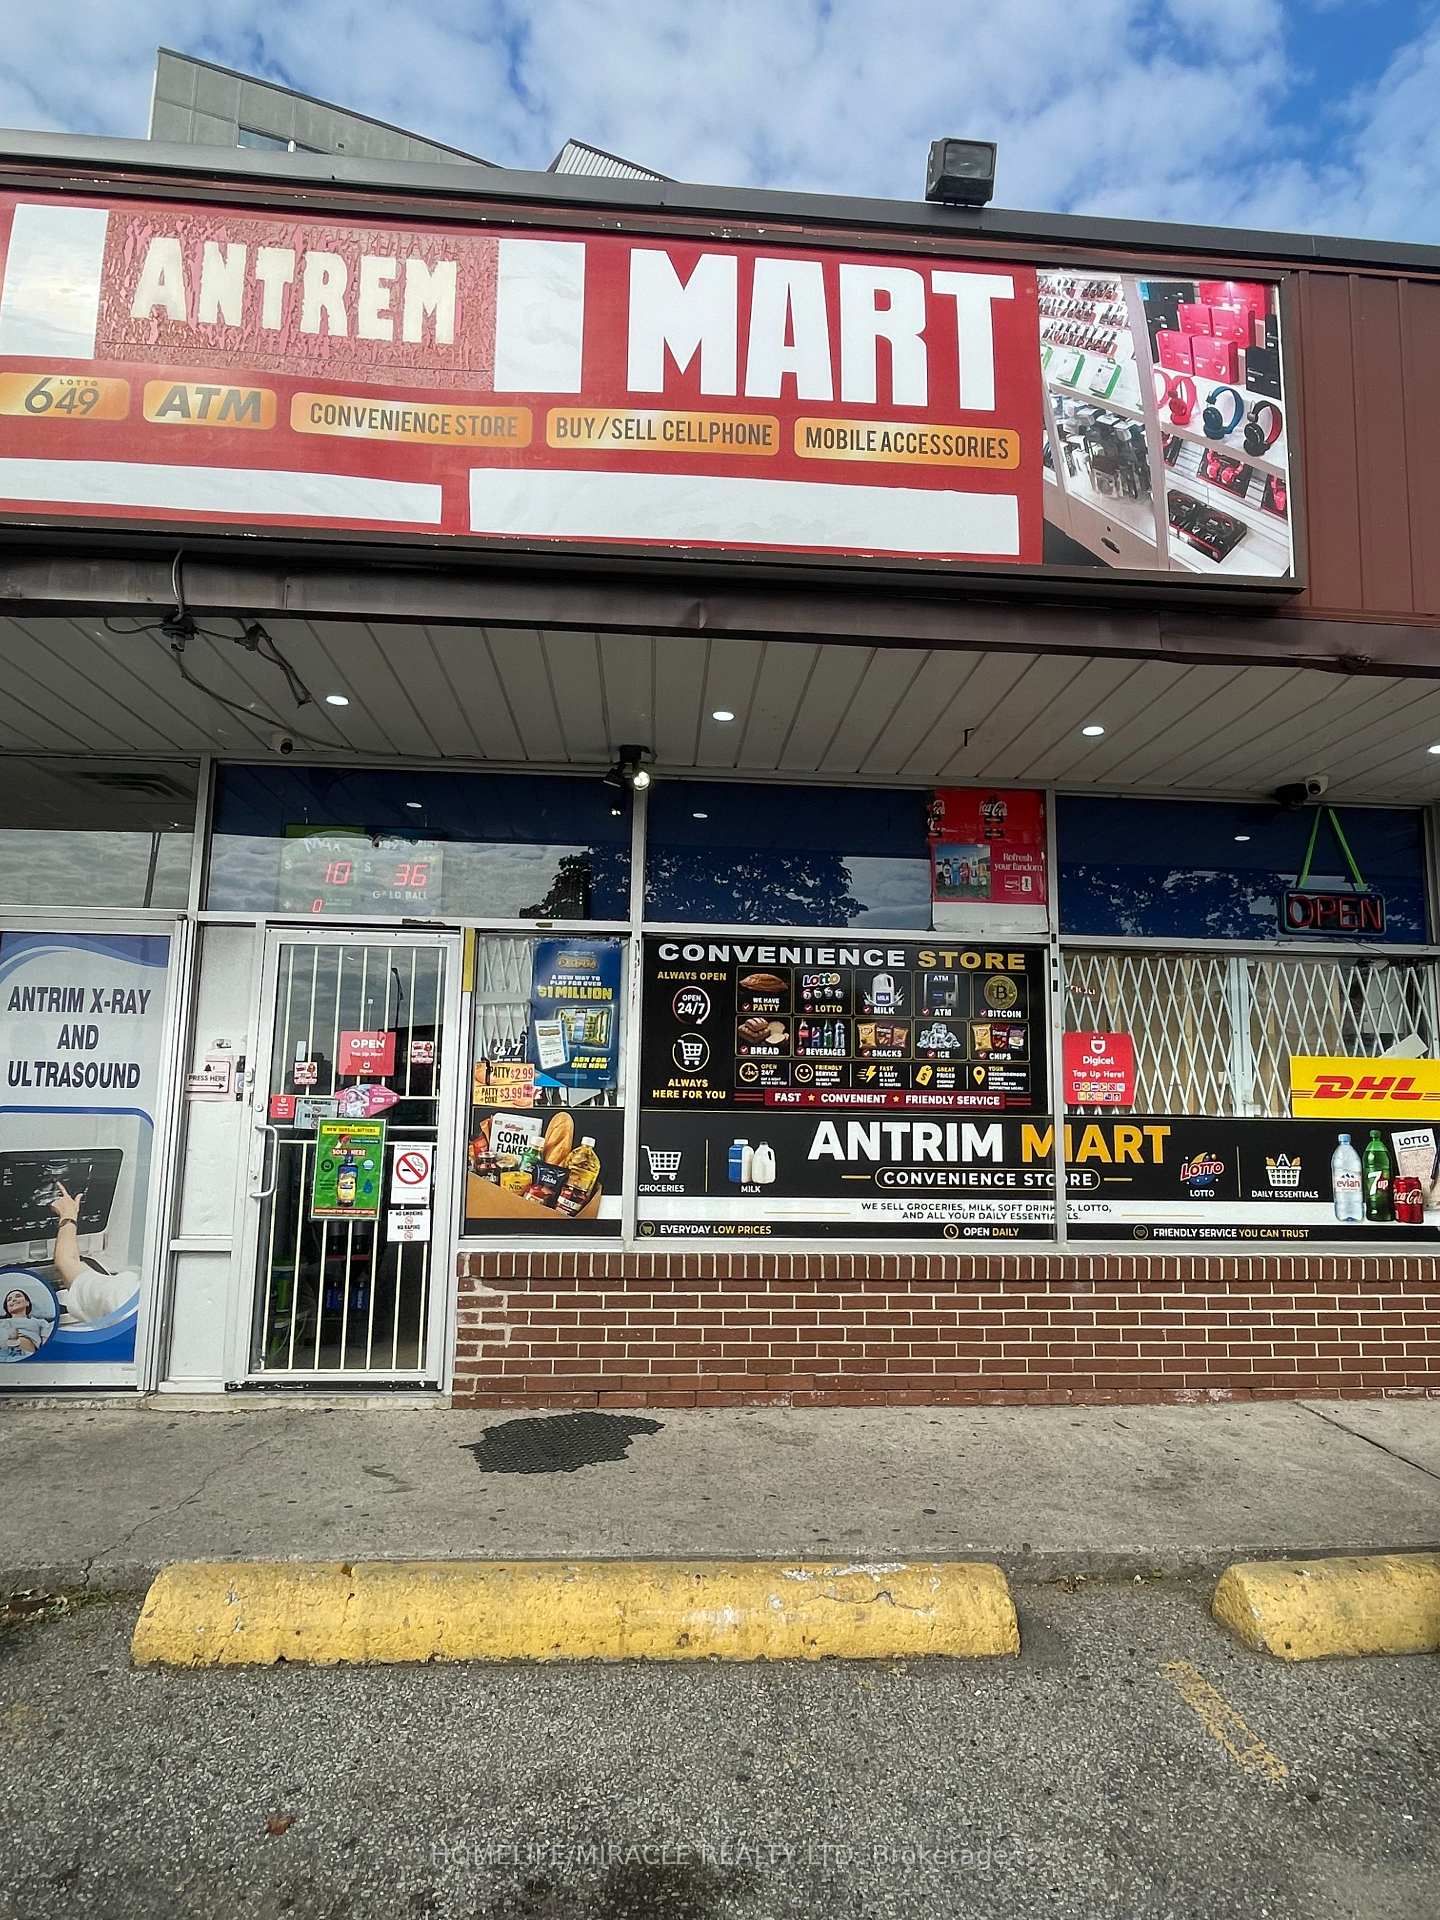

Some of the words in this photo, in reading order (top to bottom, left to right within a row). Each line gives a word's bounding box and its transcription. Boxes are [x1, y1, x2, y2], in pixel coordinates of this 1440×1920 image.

[130, 237, 457, 345] ANTREM
[626, 248, 1015, 412] MART
[25, 377, 99, 415] 649
[155, 385, 262, 423] ATM
[310, 402, 451, 435] CONVENIENCE
[455, 414, 518, 437] STORE
[556, 417, 657, 441] BUY/SELL
[662, 420, 772, 446] CELLPHONE
[806, 427, 877, 451] MOBILE
[881, 431, 1009, 460] ACCESSORIES
[1003, 853, 1032, 861] Refresh
[323, 861, 351, 885] 10
[393, 863, 428, 887] 36
[1289, 895, 1382, 929] OPEN
[658, 944, 905, 967] CONVENIENCE
[918, 951, 1026, 971] STORE
[657, 971, 697, 980] ALWAYS
[700, 972, 727, 981] OPEN
[555, 987, 613, 1000] MILLION
[8, 986, 84, 1013] ANTRIM
[90, 988, 151, 1015] X-RAY
[677, 1002, 705, 1015] 24/7
[753, 1004, 779, 1012] PATTY
[934, 1008, 952, 1016] ATM
[987, 1010, 1021, 1018] BITCOIN
[57, 1024, 99, 1050] AND
[351, 1039, 385, 1048] OPEN
[750, 1047, 779, 1055] BREAD
[1082, 1056, 1114, 1066] Digicel
[8, 1060, 140, 1088] ULTRASOUND
[490, 1067, 510, 1078] PATTY
[510, 1067, 533, 1080] $2.99
[1072, 1070, 1087, 1078] Top
[1090, 1071, 1100, 1079] Up
[668, 1079, 708, 1087] ALWAYS
[1313, 1075, 1425, 1100] DHL
[481, 1088, 498, 1096] PATTY
[500, 1088, 522, 1098] $3.99
[653, 1090, 681, 1098] HERE
[683, 1090, 702, 1098] FOR
[705, 1090, 726, 1099] YOU
[774, 1093, 801, 1102] FAST
[821, 1094, 887, 1103] CONVENIENT
[905, 1095, 955, 1104] FRIENDLY
[957, 1095, 1000, 1105] SERVICE
[497, 1131, 528, 1146] CORN
[807, 1120, 1003, 1163] ANTRIM
[1022, 1124, 1171, 1164] MART
[1399, 1135, 1429, 1146] LOTTO
[1180, 1162, 1224, 1181] LOTTO
[883, 1171, 1016, 1186] CONVENIENCE
[1024, 1173, 1092, 1186] STORE
[638, 1184, 685, 1193] GROCERIES
[1190, 1189, 1215, 1197] LOTTO
[1251, 1190, 1273, 1198] DAILY
[1274, 1190, 1319, 1198] ESSENTIALS
[907, 1203, 966, 1212] GROCERIES,
[968, 1204, 995, 1212] MILK,
[1078, 1204, 1112, 1213] LOTTO,
[948, 1212, 975, 1220] YOUR
[978, 1212, 1007, 1220] DAILY
[660, 1224, 711, 1234] EVERYDAY
[713, 1225, 736, 1234] LOW
[738, 1225, 772, 1235] PRICES
[963, 1227, 990, 1236] OPEN
[992, 1227, 1019, 1236] DAILY
[1153, 1228, 1198, 1237] FRIENDLY
[1199, 1228, 1237, 1237] SERVICE
[1239, 1229, 1257, 1237] YOU
[1260, 1229, 1279, 1237] CAN
[1281, 1229, 1309, 1238] TRUST
